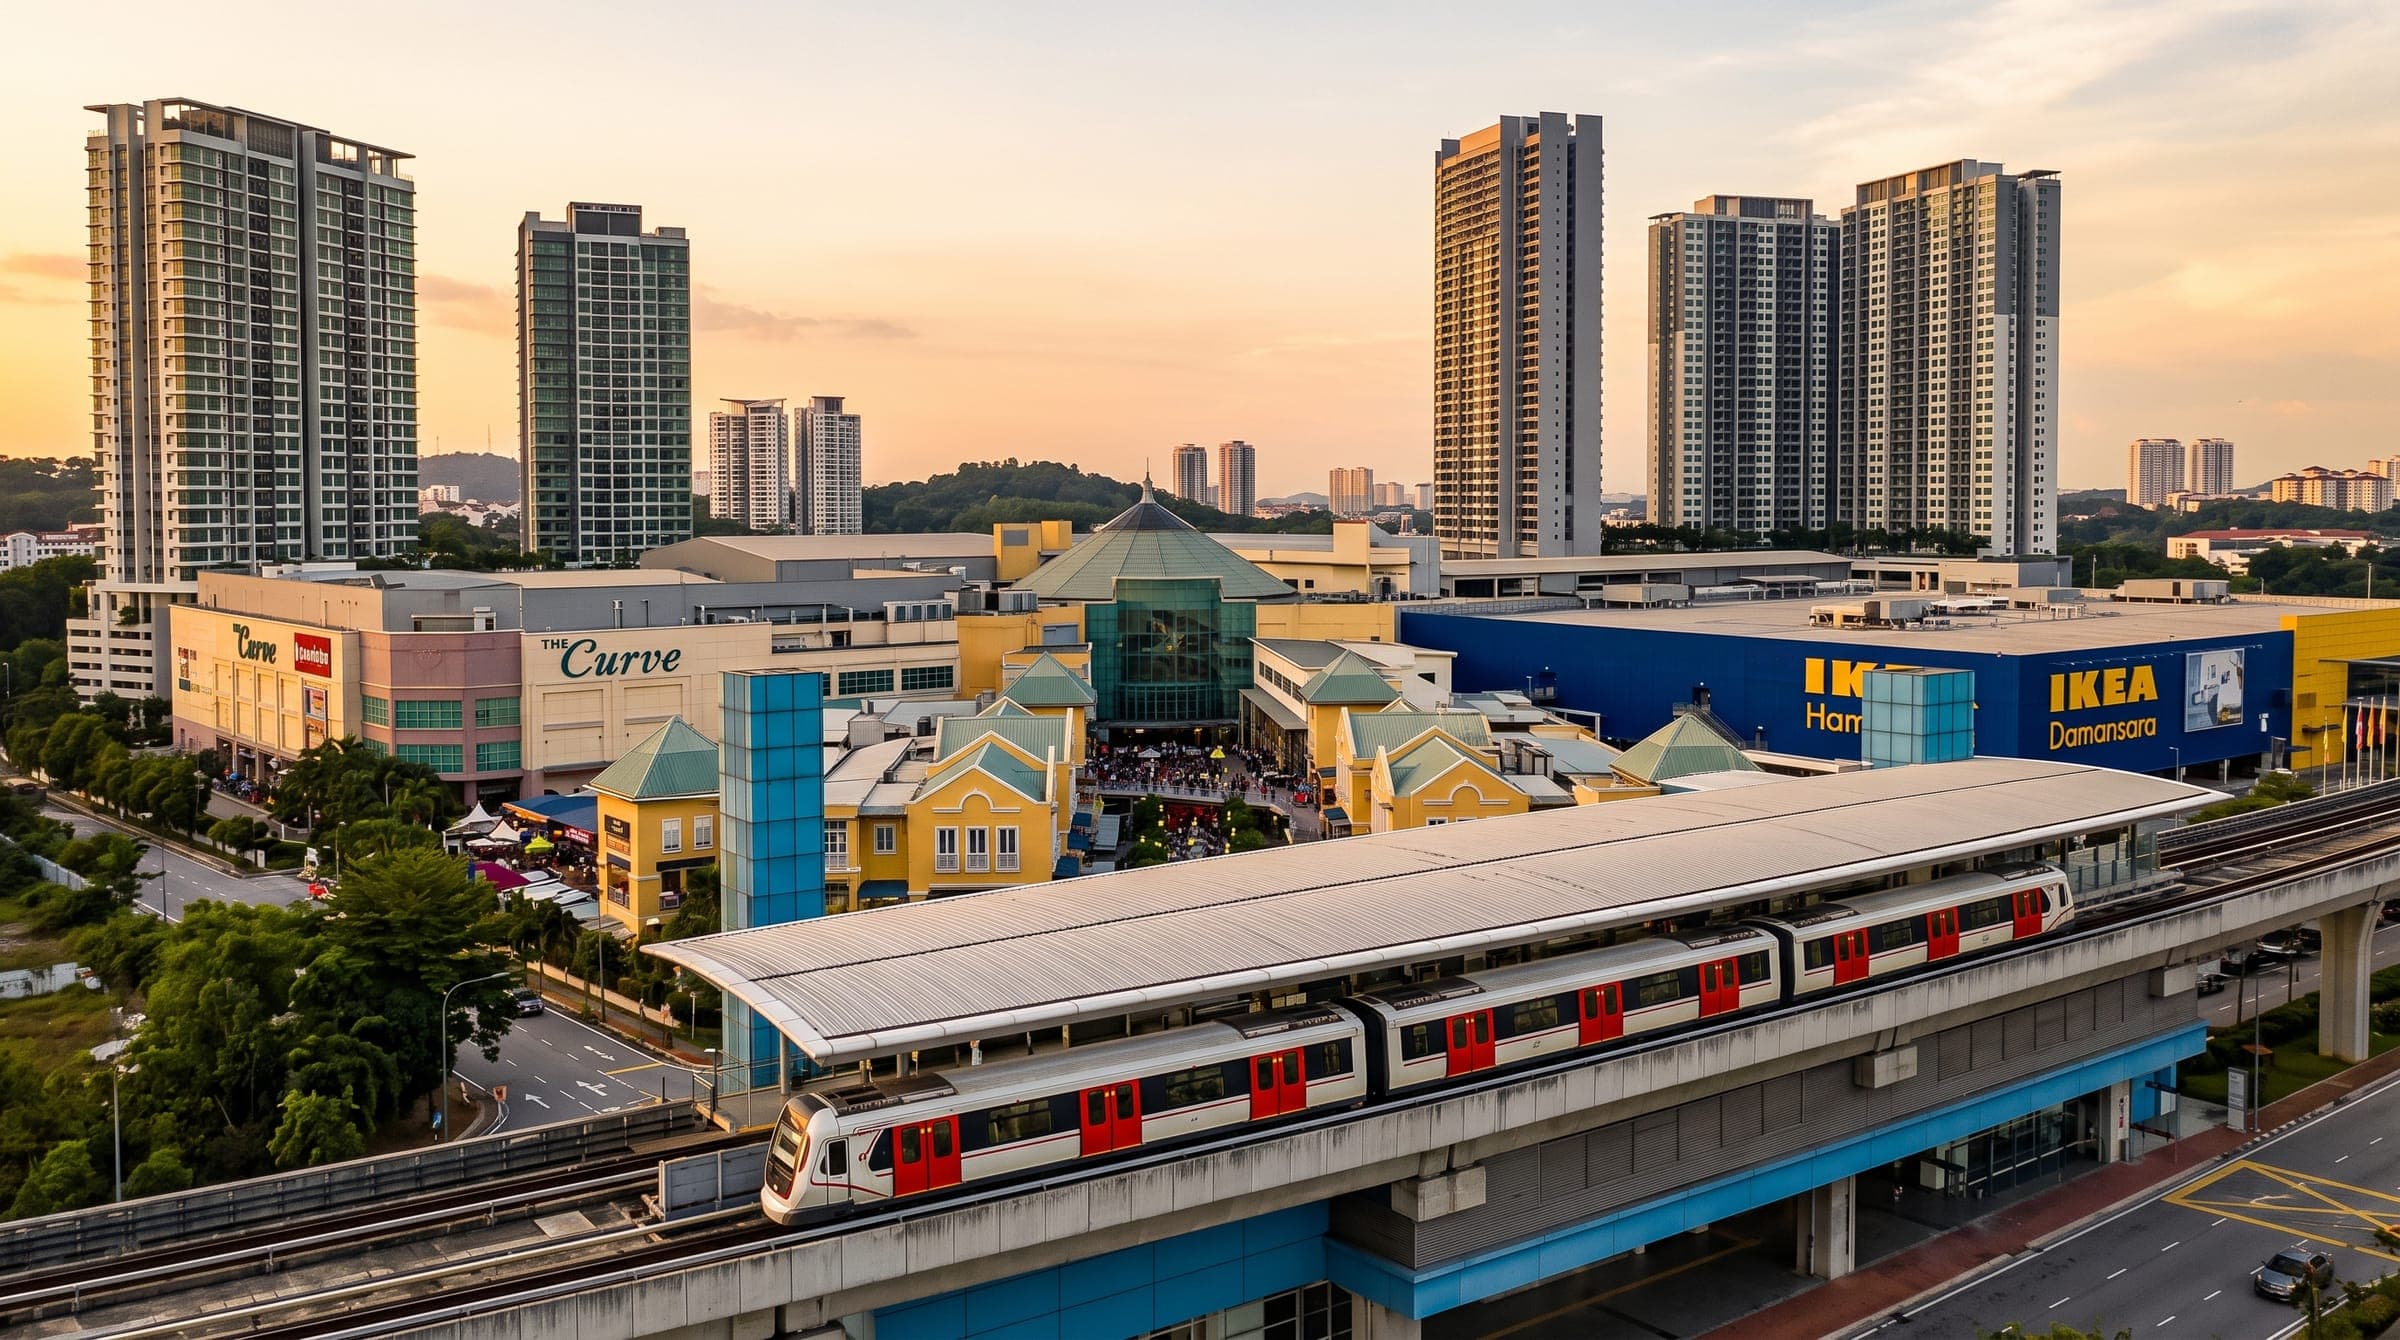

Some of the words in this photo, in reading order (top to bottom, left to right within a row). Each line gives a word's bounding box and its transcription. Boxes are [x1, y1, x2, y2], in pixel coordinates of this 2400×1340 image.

[238, 625, 276, 664] Curve
[541, 638, 569, 650] THE
[560, 638, 681, 678] Curve
[2050, 665, 2158, 712] IKEA
[2050, 717, 2156, 750] Damansara
